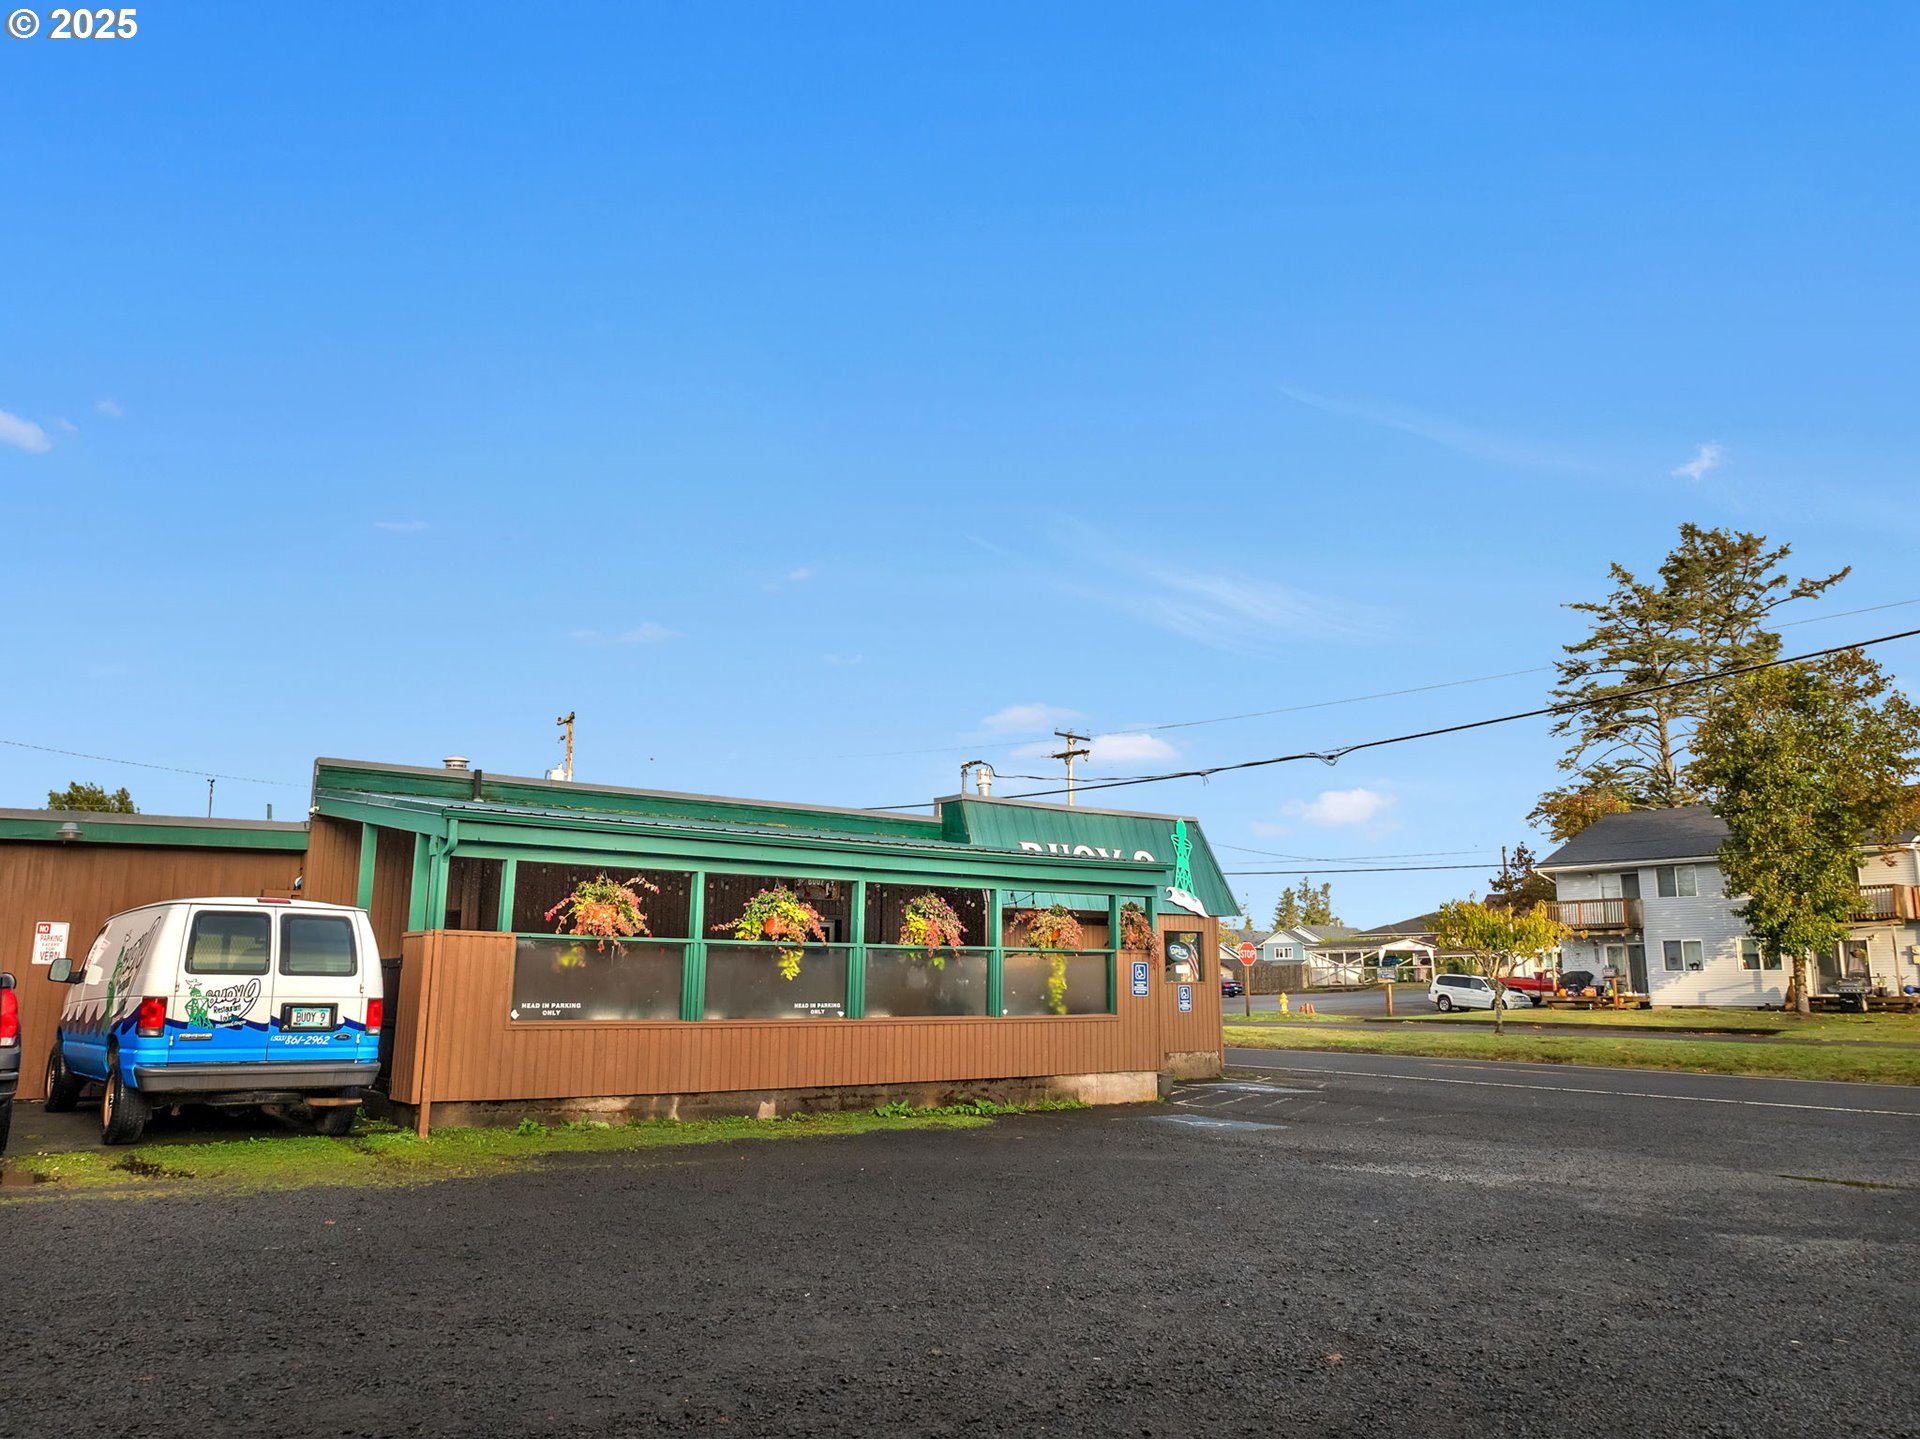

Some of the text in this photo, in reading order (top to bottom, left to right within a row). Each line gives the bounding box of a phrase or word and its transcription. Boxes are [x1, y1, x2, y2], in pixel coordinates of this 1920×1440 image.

[39, 925, 49, 933] NO
[1240, 950, 1256, 958] STOP
[296, 1012, 326, 1022] BUOY 9
